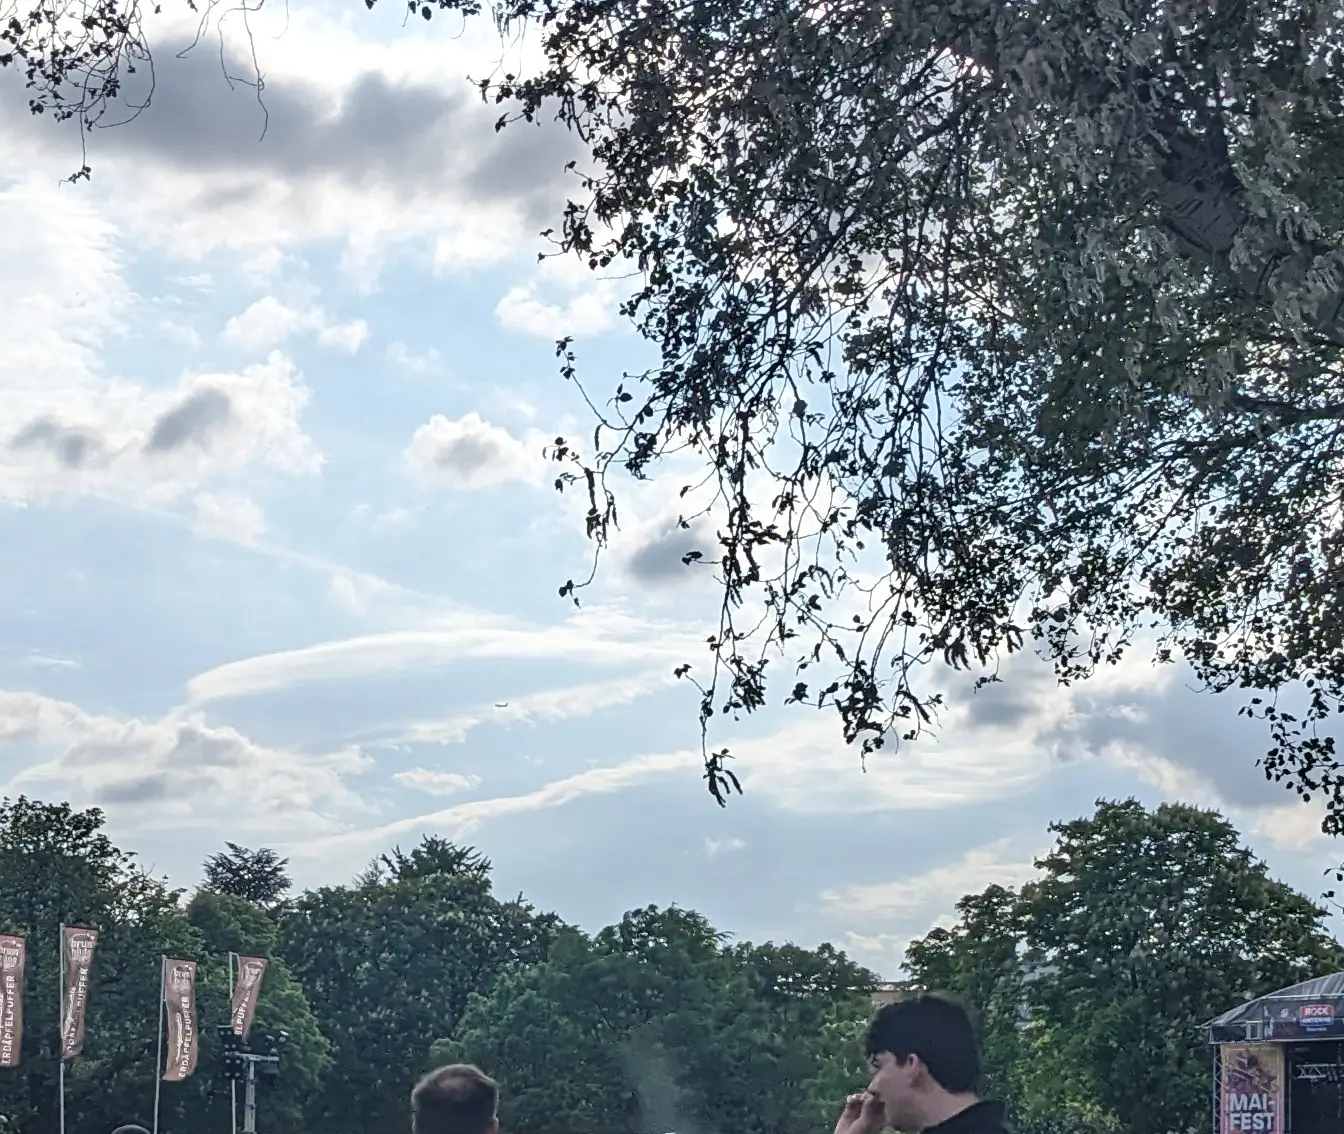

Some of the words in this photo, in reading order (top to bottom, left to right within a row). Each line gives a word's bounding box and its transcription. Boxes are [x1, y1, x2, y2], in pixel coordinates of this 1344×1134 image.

[1304, 1008, 1328, 1016] ROCK
[1230, 1093, 1275, 1111] MAI-
[1230, 1113, 1274, 1131] FEST
